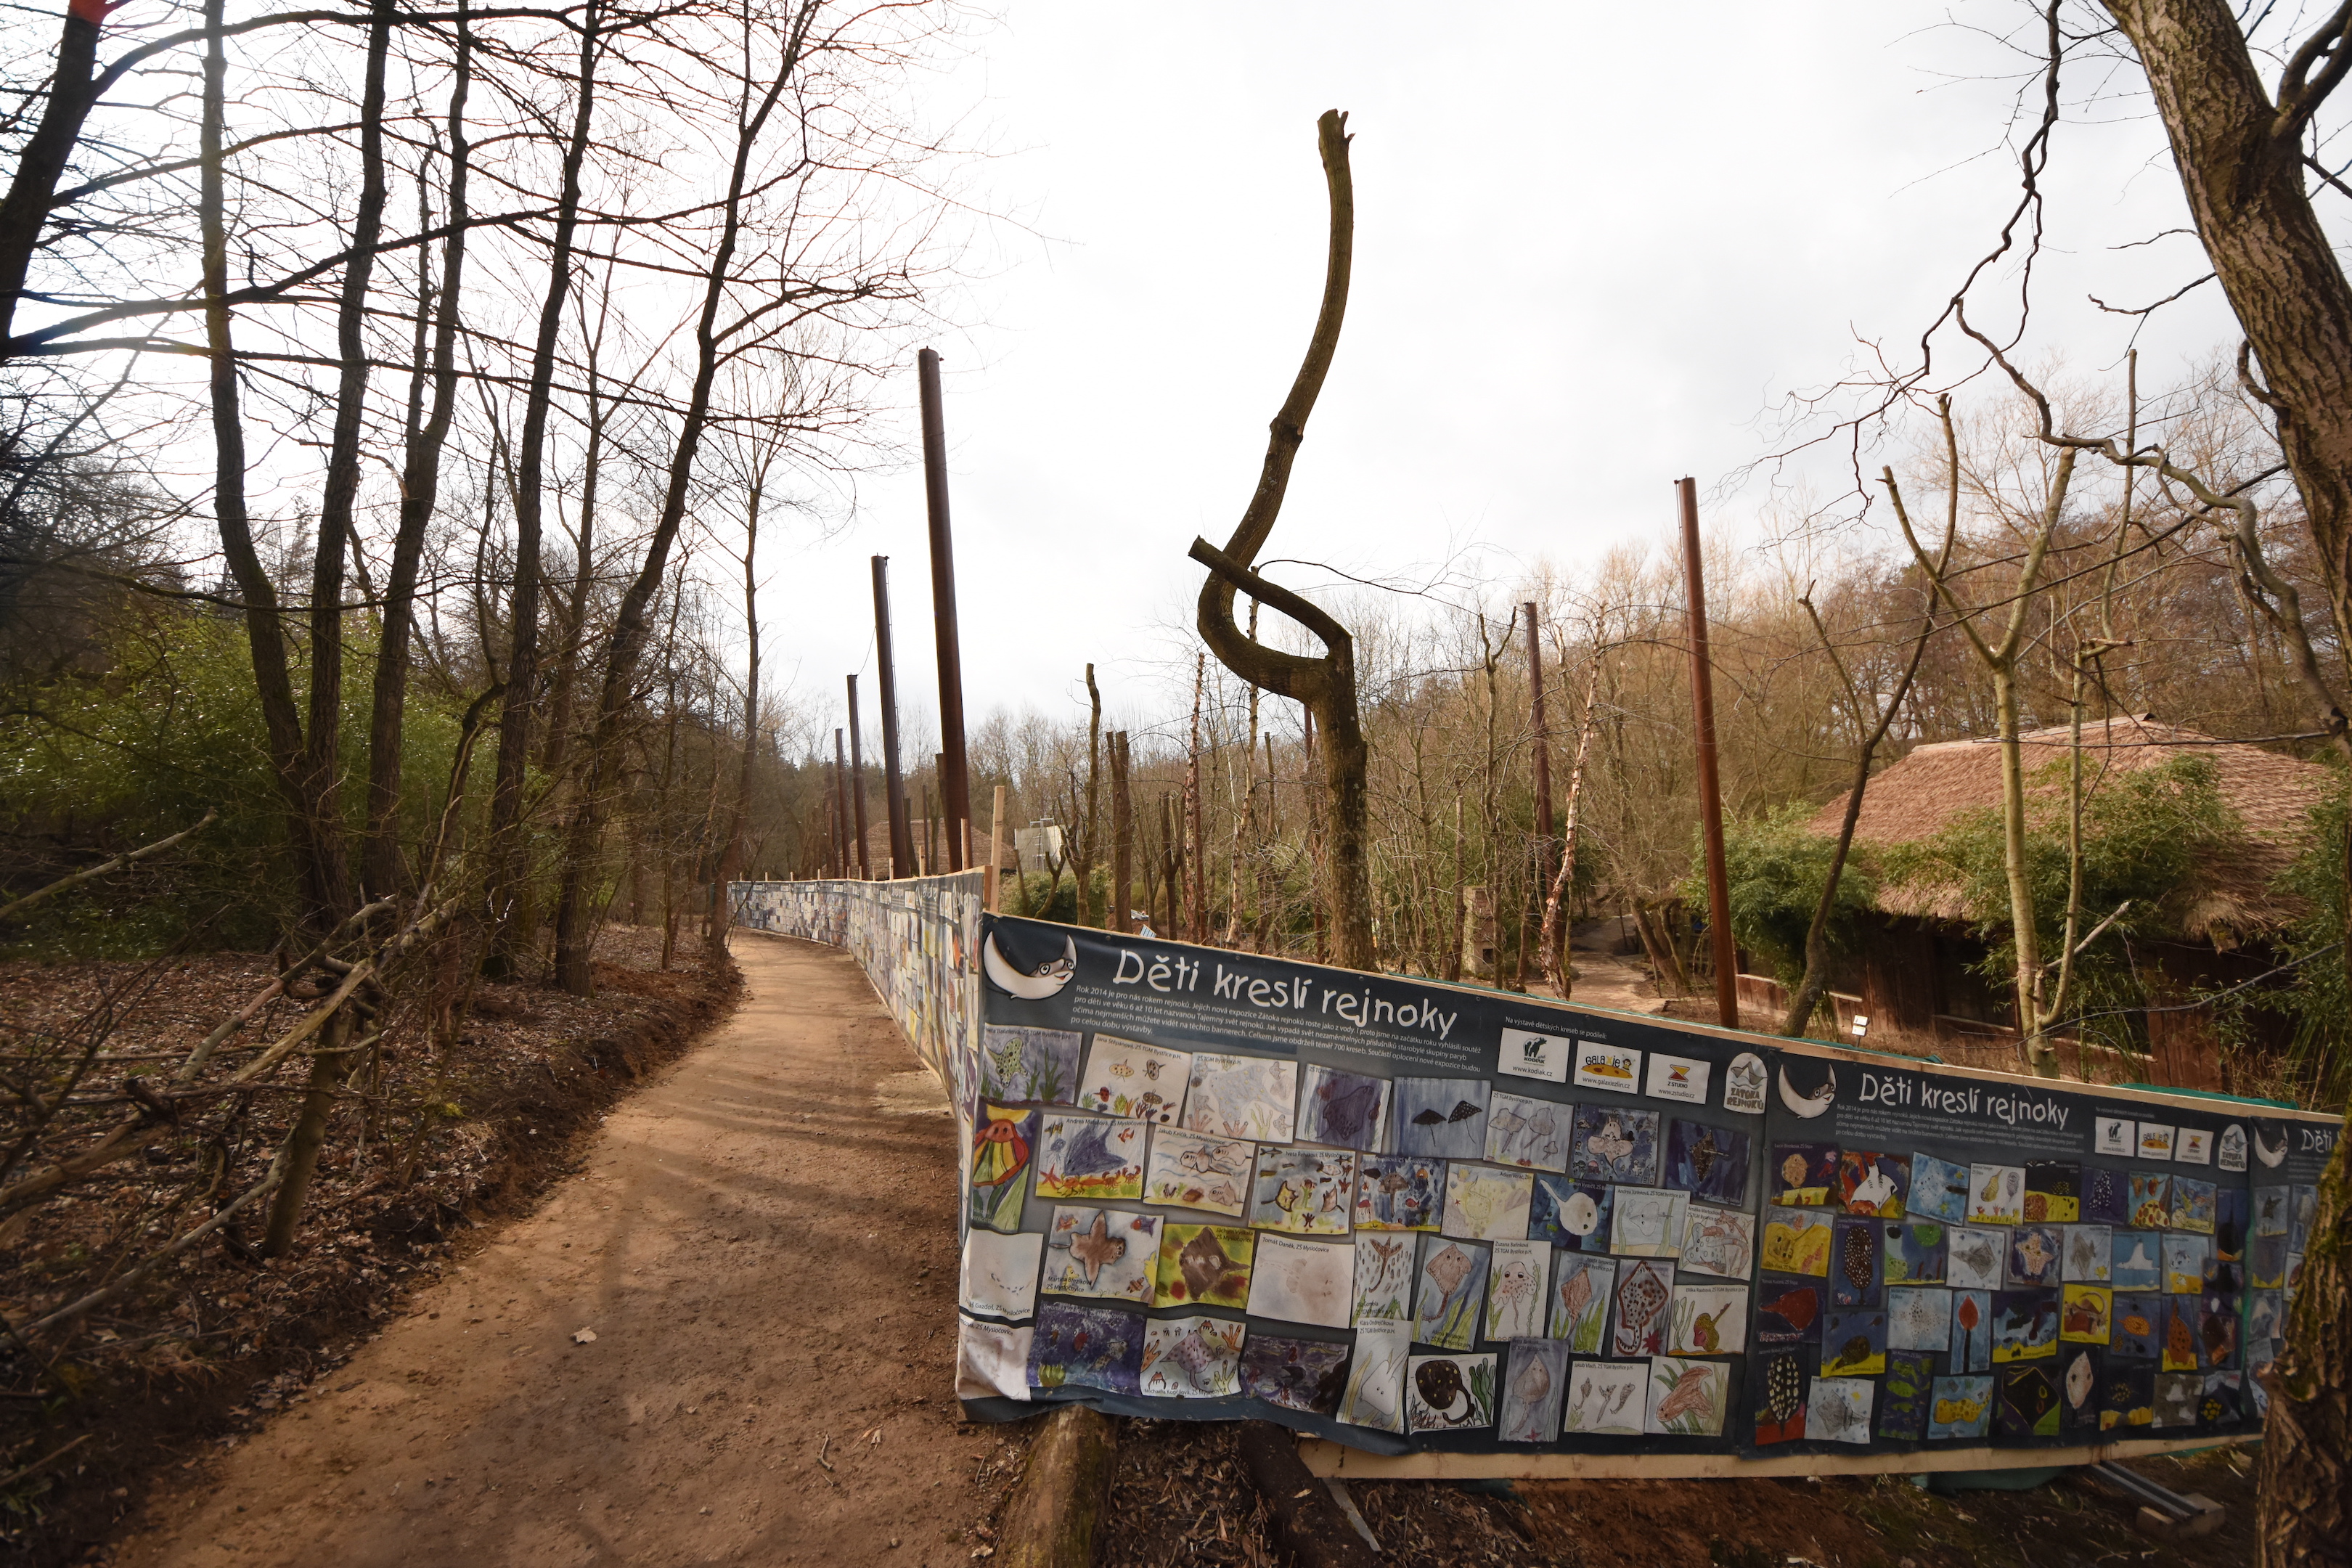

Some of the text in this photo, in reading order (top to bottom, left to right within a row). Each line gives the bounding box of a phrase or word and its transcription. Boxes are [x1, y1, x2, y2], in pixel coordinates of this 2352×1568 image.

[1112, 950, 1458, 1041] Děti kreslí rejnoky
[1076, 985, 1089, 994] Rok
[1090, 987, 1107, 996] 2014
[1107, 989, 1115, 998] je
[1164, 999, 1191, 1008] rejnoků.
[1192, 1002, 1210, 1012] Jejich
[1228, 1010, 1257, 1018] expozice
[1258, 1012, 1280, 1021] Zátoka
[1340, 1026, 1355, 1034] vody.
[1376, 1030, 1390, 1039] jsme
[1400, 1035, 1423, 1044] začátku
[1437, 1042, 1461, 1050] vyhlásili
[1082, 1018, 1101, 1026] celou
[1102, 1020, 1120, 1029] dobu
[1122, 1023, 1153, 1035] výstavby.
[1087, 997, 1102, 1006] děti
[1112, 1001, 1128, 1010] věku
[1163, 1010, 1196, 1019] nazvanou
[1196, 1013, 1224, 1025] Tajemný
[1239, 1021, 1265, 1030] rejnoků.
[1315, 1032, 1365, 1045] nezaměnitelných
[1366, 1039, 1397, 1049] příslušníků
[1397, 1045, 1425, 1055] starobylé
[1426, 1048, 1449, 1059] skupiny
[1514, 1018, 1535, 1027] výstavě
[1535, 1022, 1559, 1032] dětských
[1073, 1005, 1093, 1015] očima
[1095, 1010, 1134, 1021] nejmenších
[1135, 1015, 1160, 1024] můžete
[1161, 1018, 1178, 1027] vidět
[1189, 1022, 1210, 1032] těchto
[1212, 1025, 1246, 1037] bannerech.
[1249, 1031, 1271, 1040] Celkem
[1289, 1037, 1315, 1047] obdrželi
[1315, 1040, 1334, 1050] téměř
[1346, 1045, 1367, 1055] kreseb.
[1368, 1048, 1392, 1058] Součástí
[1392, 1053, 1418, 1062] oplocení
[1461, 1063, 1481, 1072] budou
[1512, 1066, 1553, 1077] www.kodiak.cz
[1583, 1077, 1630, 1089] www.galaxiezlin.cz
[1658, 1089, 1695, 1098] www.zstudio.cz
[1858, 1072, 2069, 1131] Děti kreslí rejnoky
[2301, 1128, 2332, 1153] Děti
[983, 1326, 1013, 1336] Mysločovice
